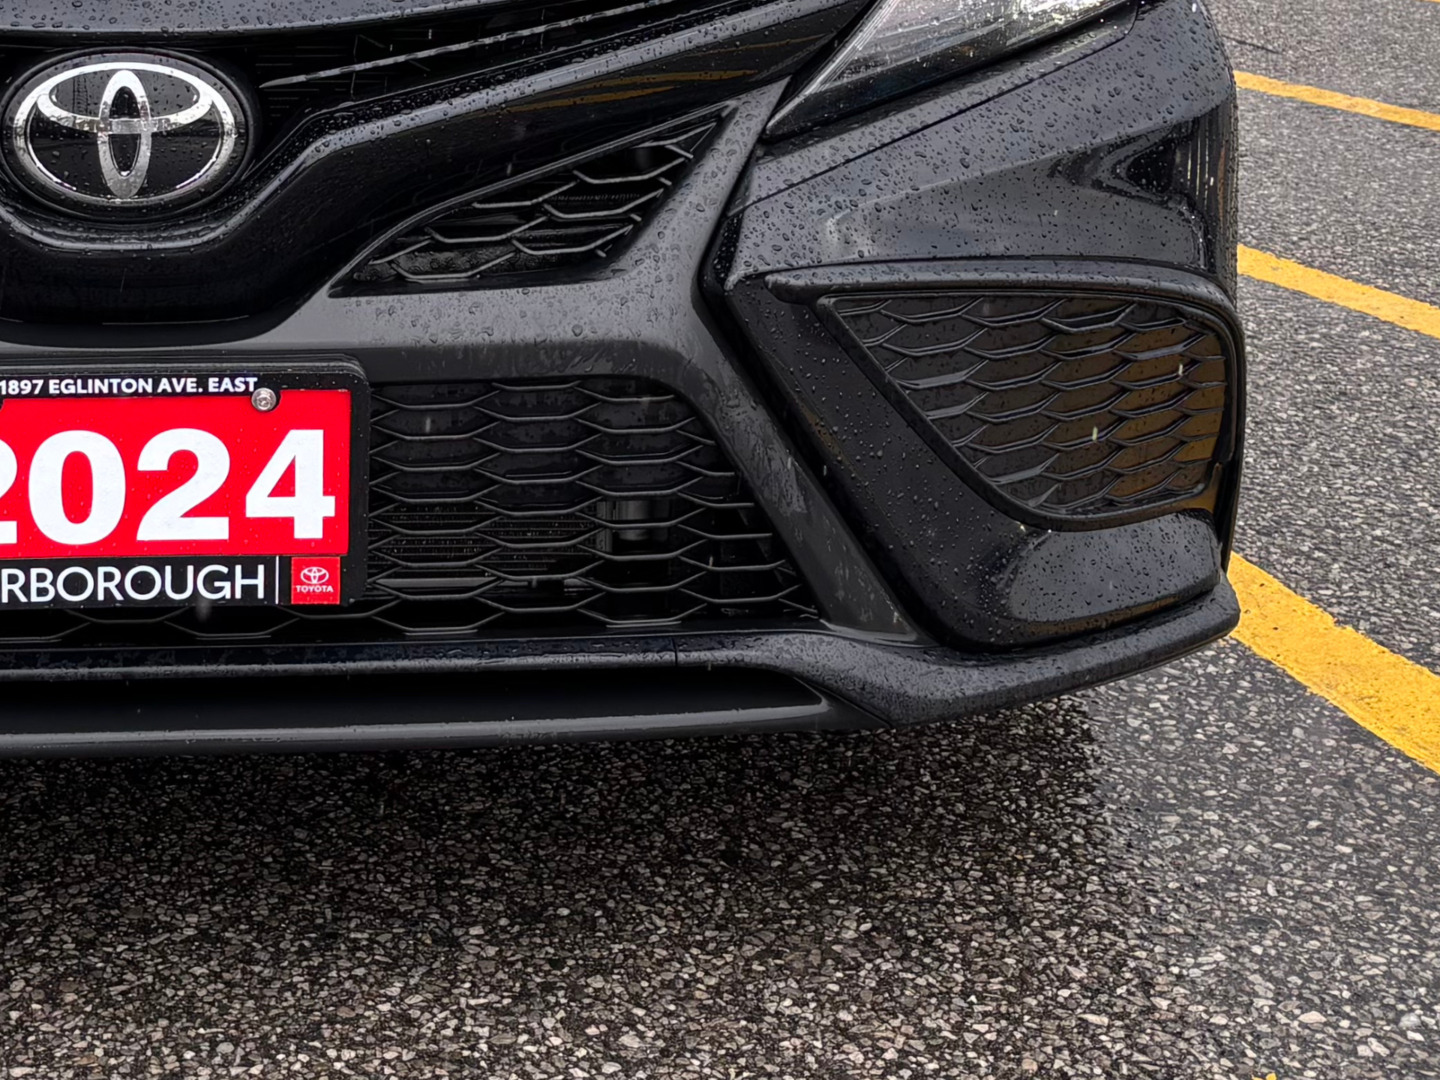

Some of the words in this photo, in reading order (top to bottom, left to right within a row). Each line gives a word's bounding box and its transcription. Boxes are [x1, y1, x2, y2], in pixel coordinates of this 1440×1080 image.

[48, 379, 153, 394] EGLINTON
[157, 378, 203, 393] AVE.
[208, 377, 258, 393] EAST
[296, 585, 334, 593] TOYOTA
